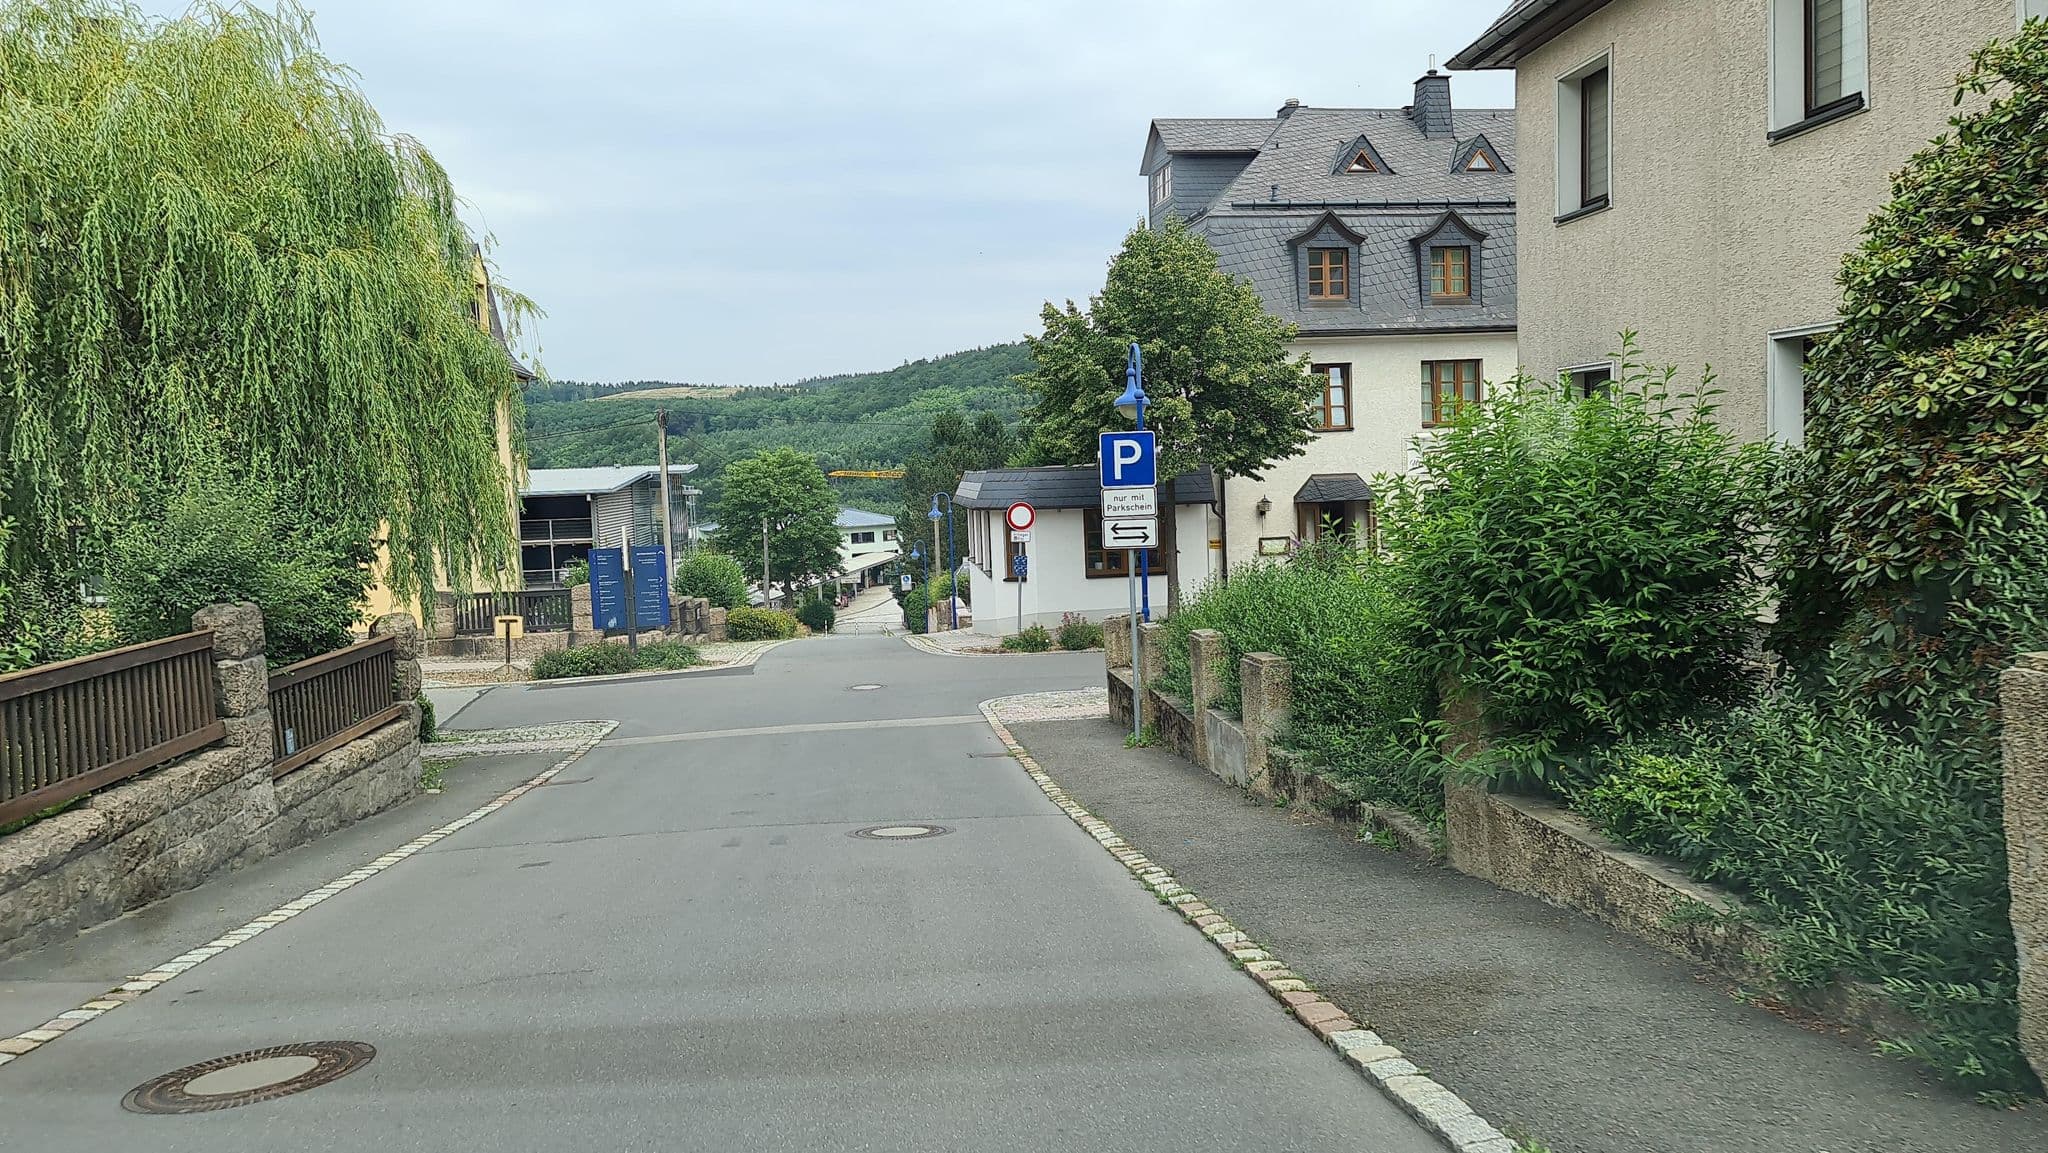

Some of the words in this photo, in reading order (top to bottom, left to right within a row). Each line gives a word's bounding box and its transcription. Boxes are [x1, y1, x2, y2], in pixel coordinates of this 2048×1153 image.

[1113, 439, 1142, 480] P
[1131, 493, 1144, 501] mit
[1107, 503, 1152, 511] Parkschein
